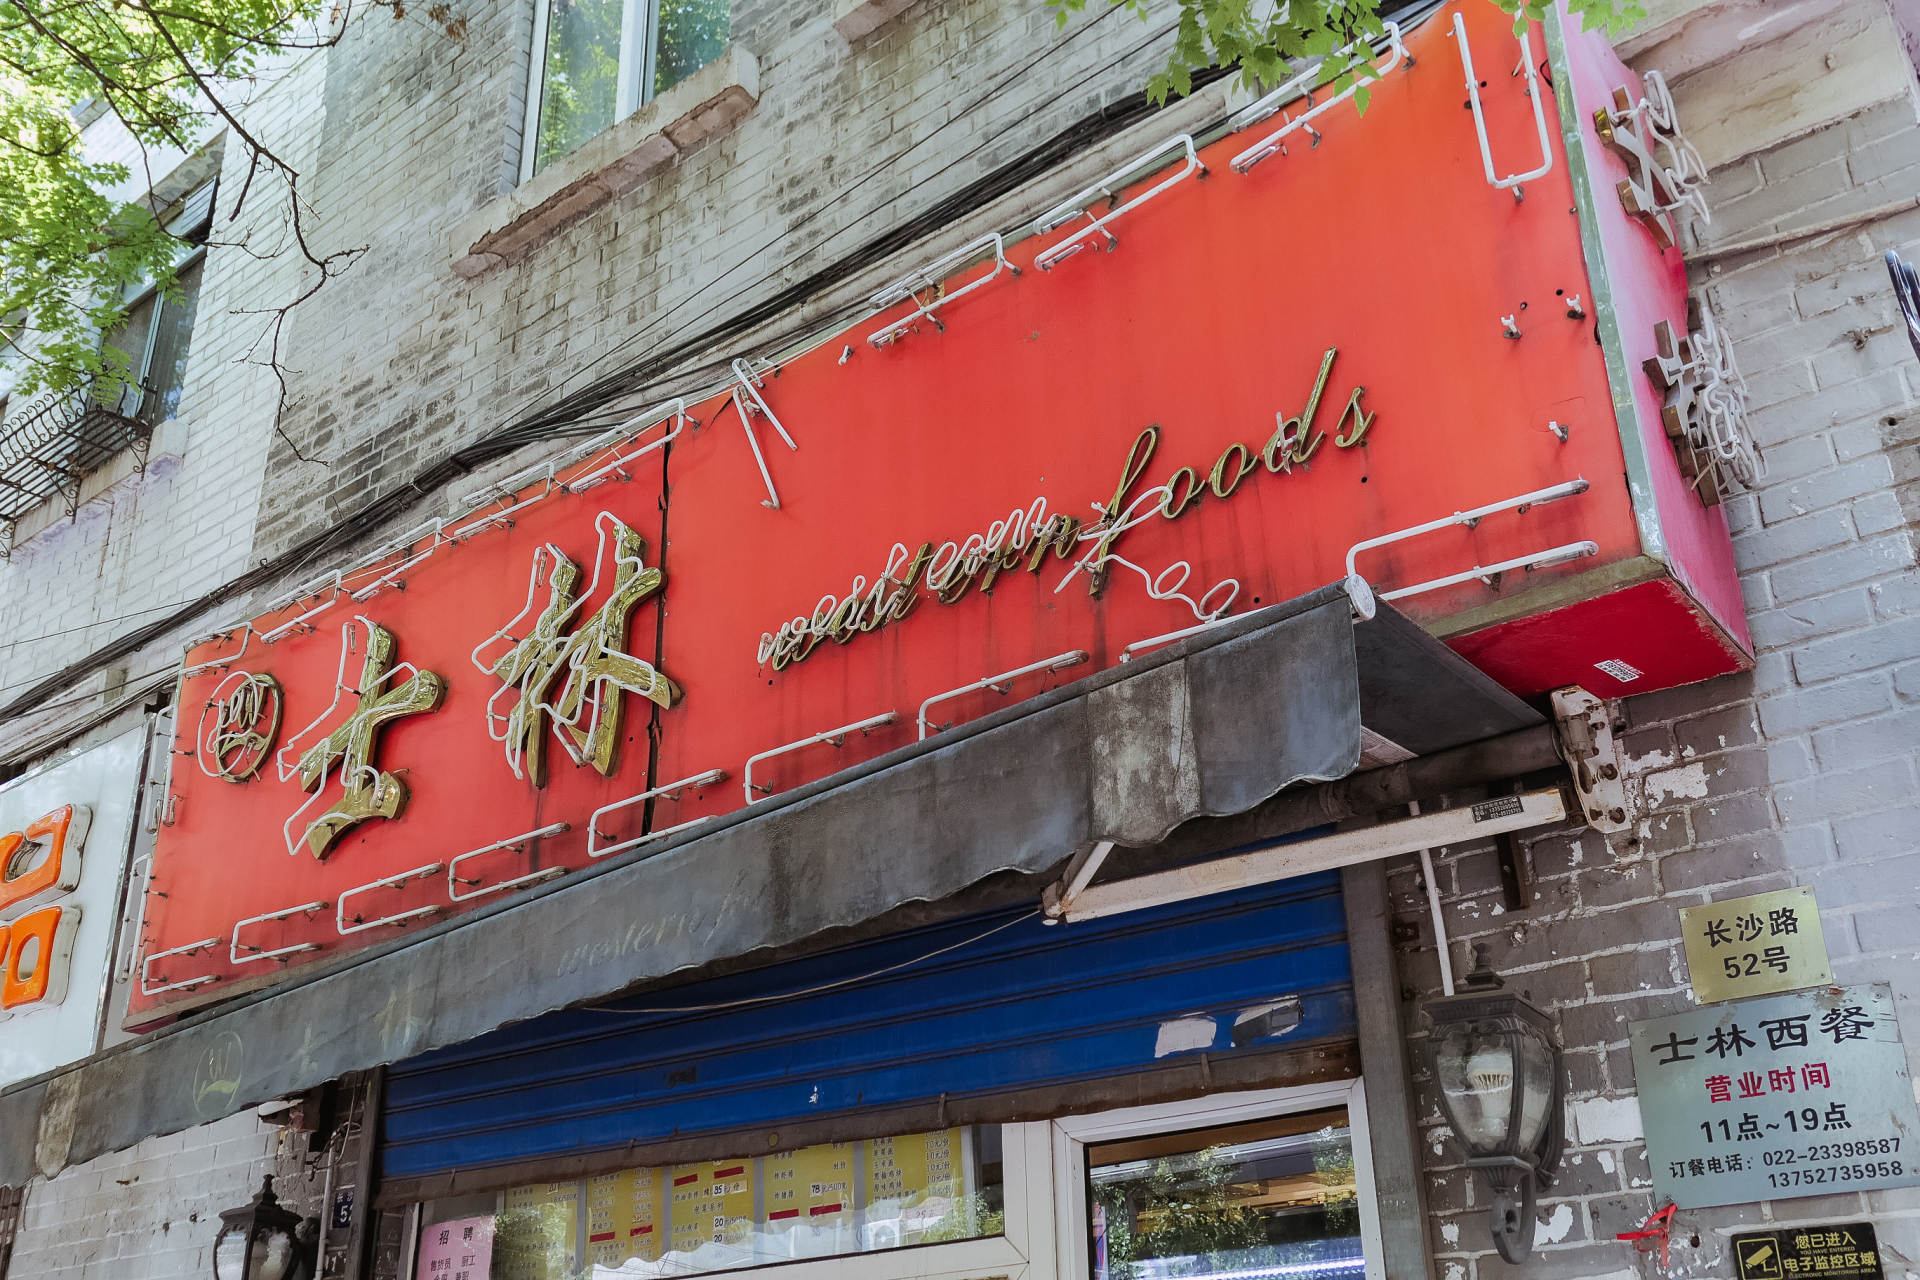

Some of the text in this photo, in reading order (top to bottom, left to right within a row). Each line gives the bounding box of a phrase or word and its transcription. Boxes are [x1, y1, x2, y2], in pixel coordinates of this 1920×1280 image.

[1086, 345, 1376, 598] foods
[278, 514, 684, 860] 士林
[1703, 906, 1799, 949] 长沙路
[1723, 945, 1791, 979] 52号
[1650, 1005, 1875, 1065] 士林西餐
[1704, 1062, 1831, 1103] 营业时间
[1700, 1101, 1853, 1143] 11点~19点
[1762, 1137, 1901, 1167] 022-23398587
[1768, 1160, 1903, 1189] 13752735958
[1795, 1231, 1857, 1250] 您已进入
[1783, 1251, 1877, 1273] 电子监控区域
